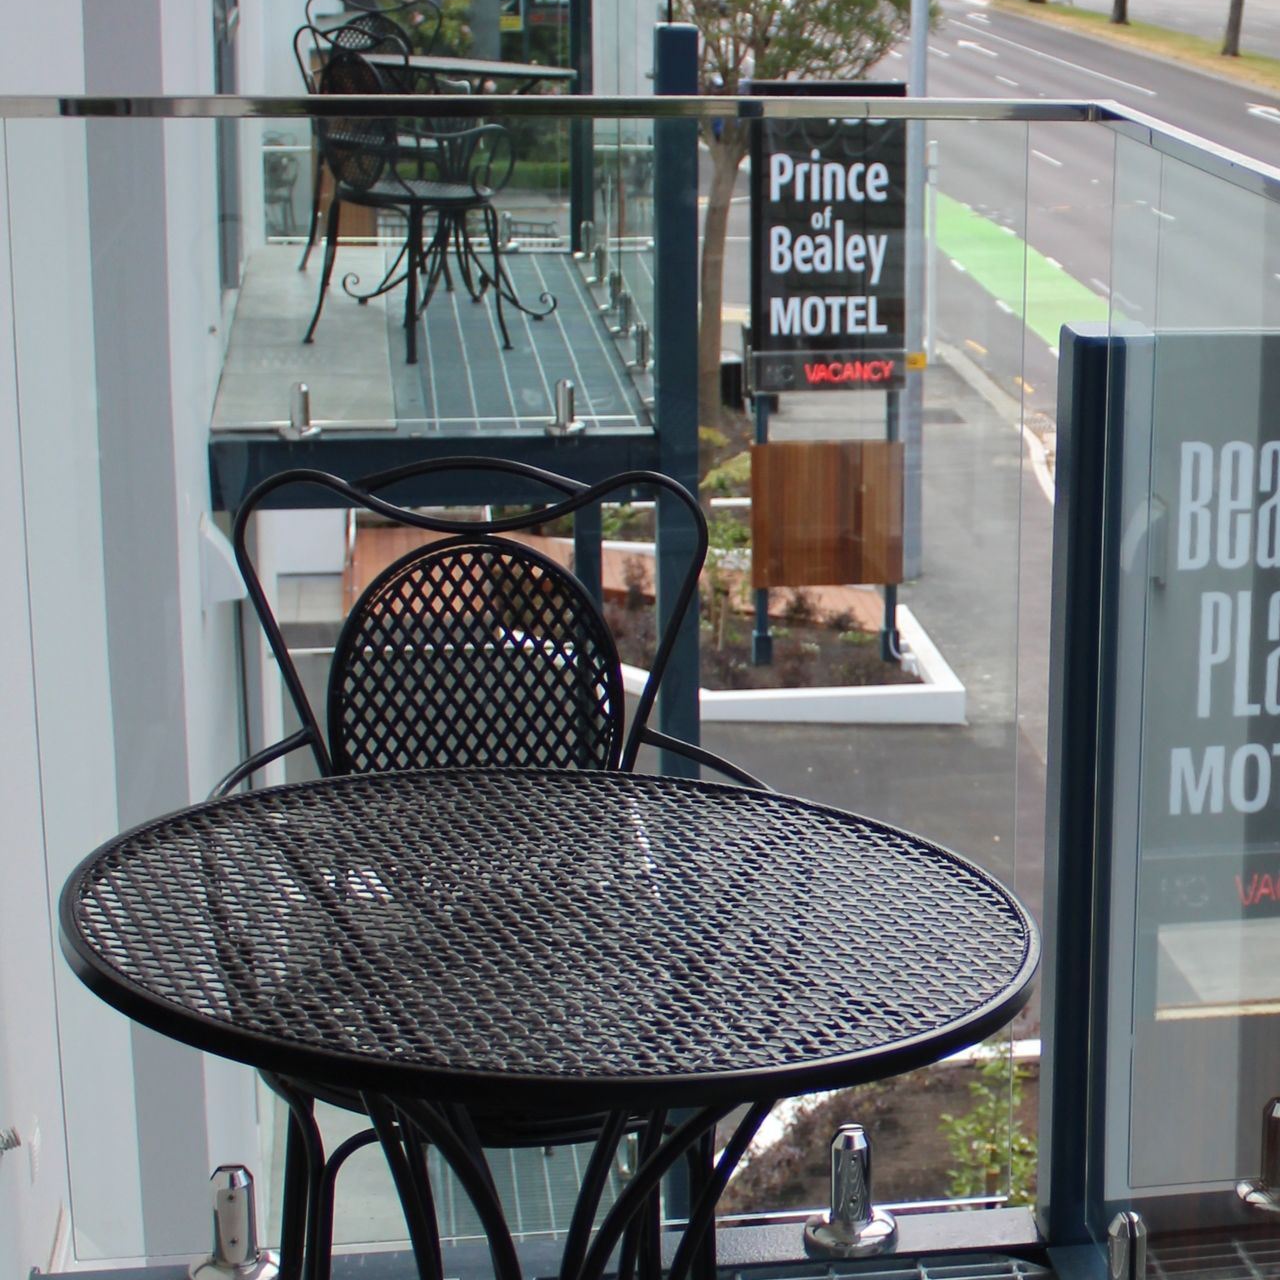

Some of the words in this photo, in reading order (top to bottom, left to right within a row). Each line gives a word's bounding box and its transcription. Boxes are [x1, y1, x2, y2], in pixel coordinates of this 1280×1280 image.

[770, 148, 889, 202] Prince
[811, 206, 832, 229] of
[770, 220, 888, 285] Bealey
[770, 296, 888, 335] MOTEL
[803, 360, 894, 384] VACANCY
